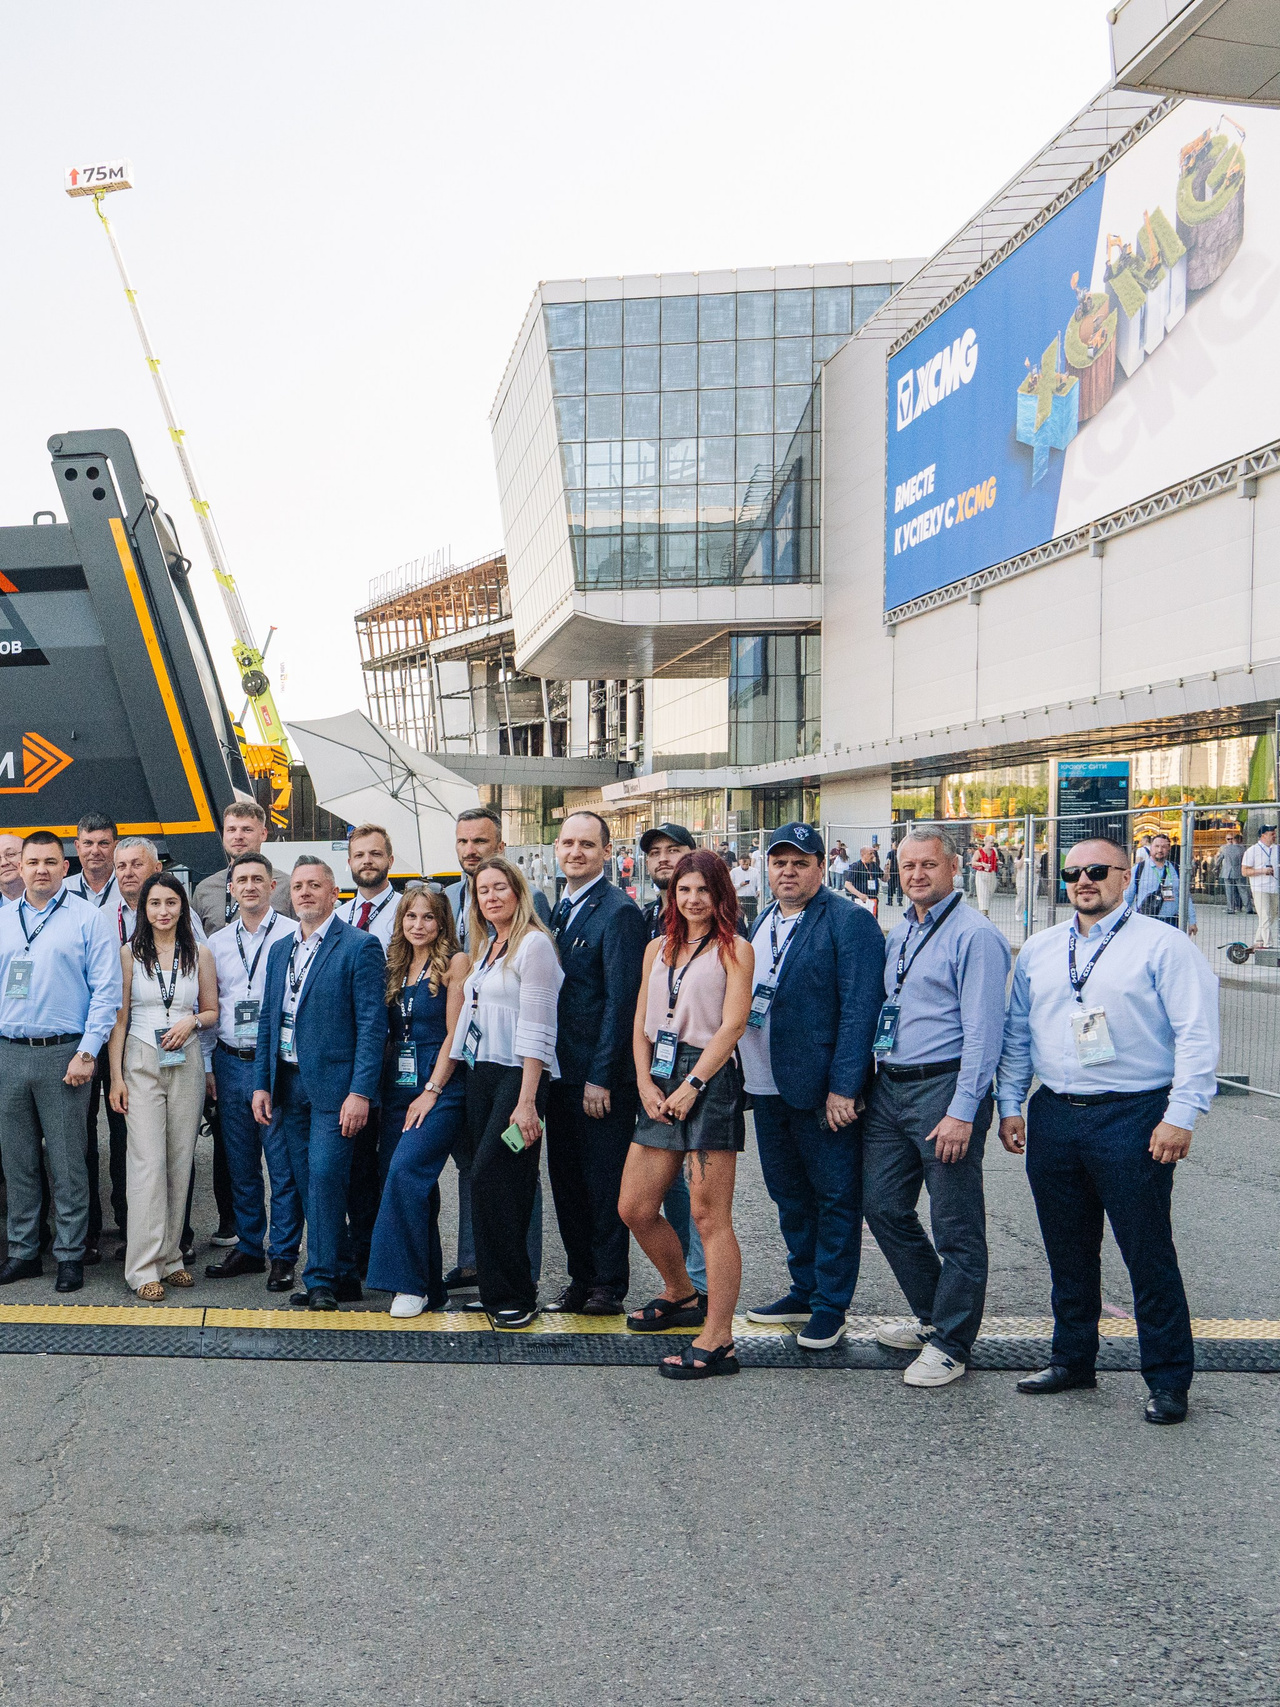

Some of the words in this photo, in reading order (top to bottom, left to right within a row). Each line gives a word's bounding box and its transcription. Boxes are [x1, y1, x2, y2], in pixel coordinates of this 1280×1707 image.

[913, 328, 979, 420] XCMG
[894, 463, 936, 514] ВМЕСТЕ
[894, 526, 903, 556] К
[903, 502, 945, 551] УСПЕХУ
[955, 476, 997, 524] XCMG
